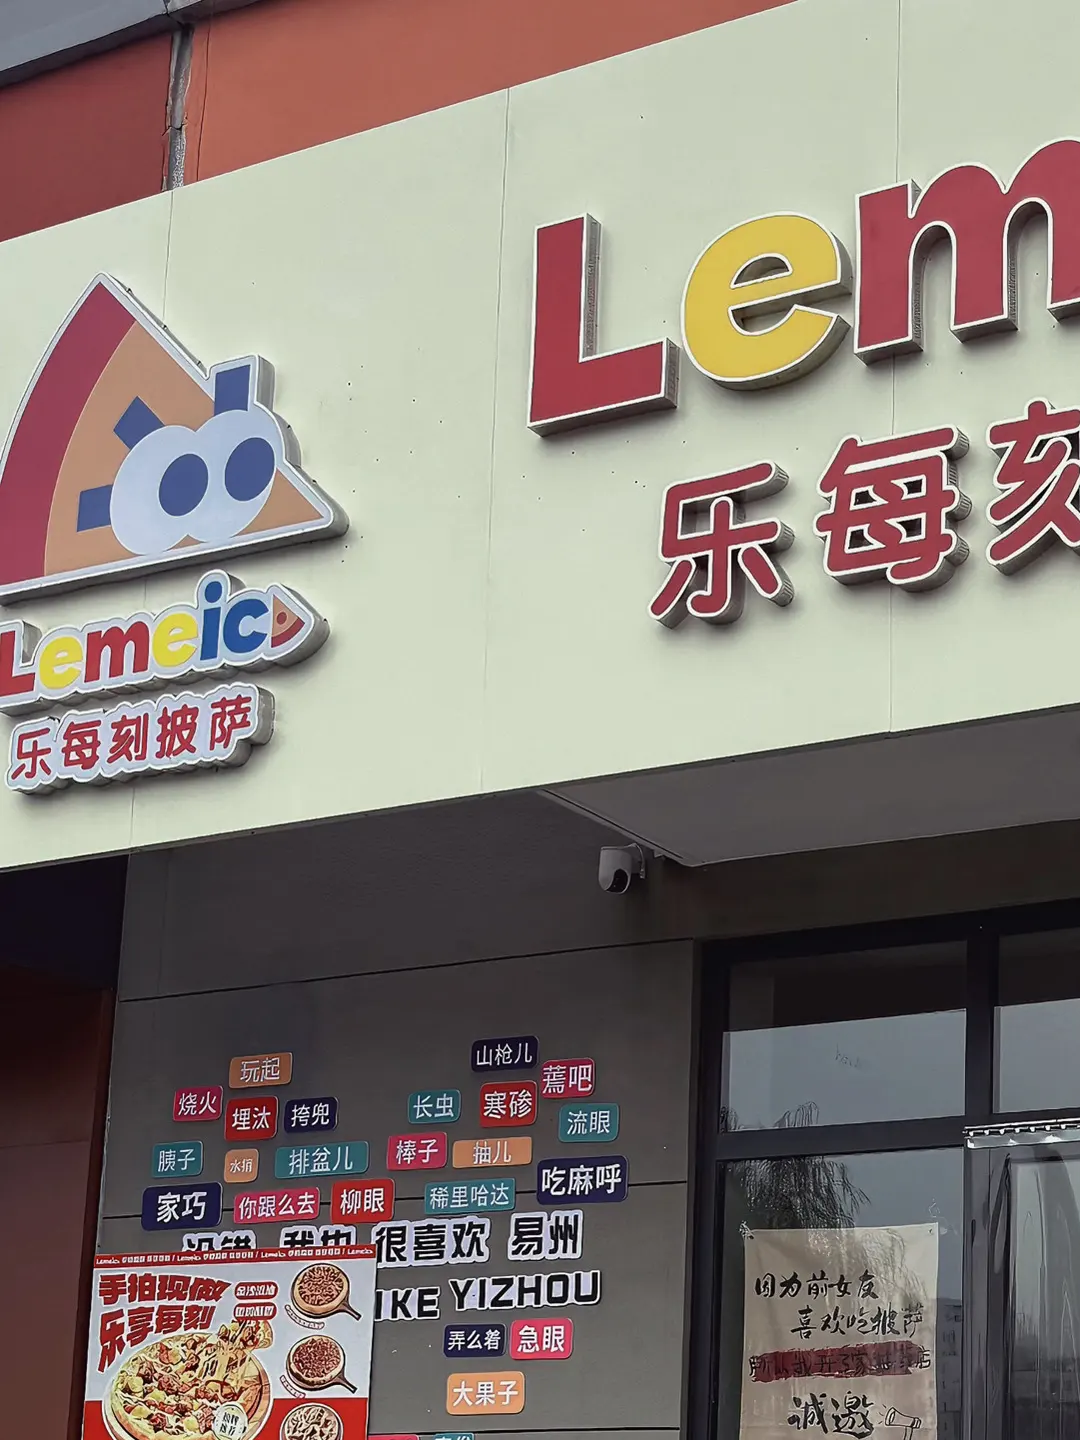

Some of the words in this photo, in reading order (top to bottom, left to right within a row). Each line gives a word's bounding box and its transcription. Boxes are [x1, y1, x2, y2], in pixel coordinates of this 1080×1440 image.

[0, 580, 270, 697] Lemeic
[11, 694, 252, 781] 乐每刻披萨
[240, 1057, 280, 1083] 玩起
[542, 1065, 593, 1094] 蔫吧
[178, 1091, 217, 1116] 烧火
[231, 1106, 272, 1130] 埋汰
[291, 1102, 330, 1128] 挎兜
[412, 1093, 454, 1119] 长虫
[483, 1089, 533, 1119] 寒碜
[158, 1149, 196, 1173] 胰子
[289, 1146, 353, 1175] 排盆儿
[396, 1139, 439, 1165] 棒子
[541, 1163, 622, 1196] 吃麻呼
[156, 1191, 208, 1222] 家巧
[238, 1193, 315, 1223] 你跟么去
[339, 1188, 385, 1216] 柳眼
[429, 1182, 510, 1210] 稀里哈达
[375, 1220, 487, 1264] 很喜欢
[511, 1213, 580, 1256] 易州
[98, 1272, 232, 1306] 手拍现做
[449, 1271, 600, 1310] YIZHOU
[754, 1270, 878, 1301] 因为前女友
[790, 1304, 925, 1339] 喜欢吃披萨
[97, 1304, 217, 1373] 乐享每刻
[516, 1325, 565, 1353] 急眼
[452, 1380, 519, 1407] 大果子
[787, 1391, 875, 1439] 诚邀
